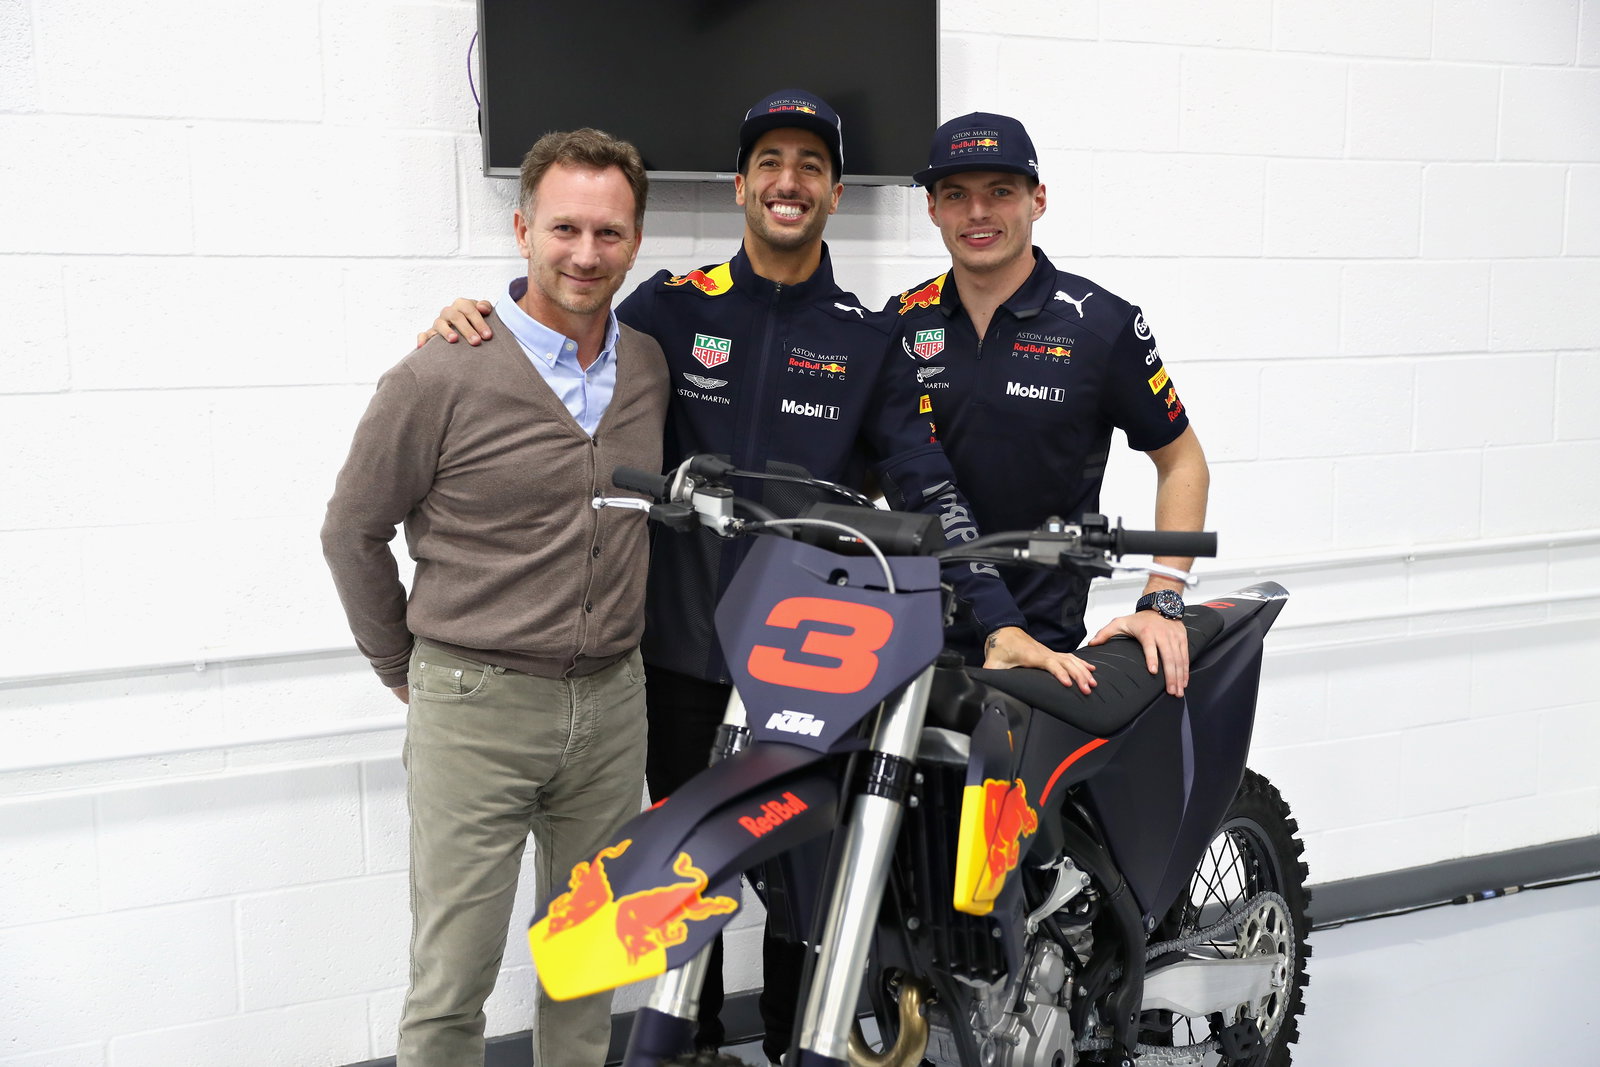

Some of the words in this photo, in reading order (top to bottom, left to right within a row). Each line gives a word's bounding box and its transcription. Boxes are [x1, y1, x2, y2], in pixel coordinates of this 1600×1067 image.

[792, 99, 817, 109] MARTIN
[952, 131, 971, 140] ASTON
[963, 140, 976, 148] Bull
[950, 147, 998, 156] RACING
[918, 331, 942, 341] TAG
[1016, 332, 1041, 341] ASTON
[1043, 335, 1074, 344] MARTIN
[699, 336, 728, 350] TAG
[1014, 343, 1030, 352] Red
[1030, 345, 1045, 353] Bull
[791, 347, 815, 358] ASTON
[916, 343, 942, 357] HEUER
[694, 348, 728, 366] HEUER
[1012, 351, 1071, 364] RACING
[789, 358, 804, 368] Red
[805, 360, 820, 370] Bull
[788, 368, 846, 380] RACING
[1006, 382, 1047, 400] Mobil
[701, 394, 731, 405] MARTIN
[781, 399, 822, 418] Mobil
[945, 526, 1000, 577] Rd
[747, 597, 895, 694] 3
[765, 709, 825, 737] KTM
[738, 804, 784, 838] Red
[767, 791, 808, 820] Bull
